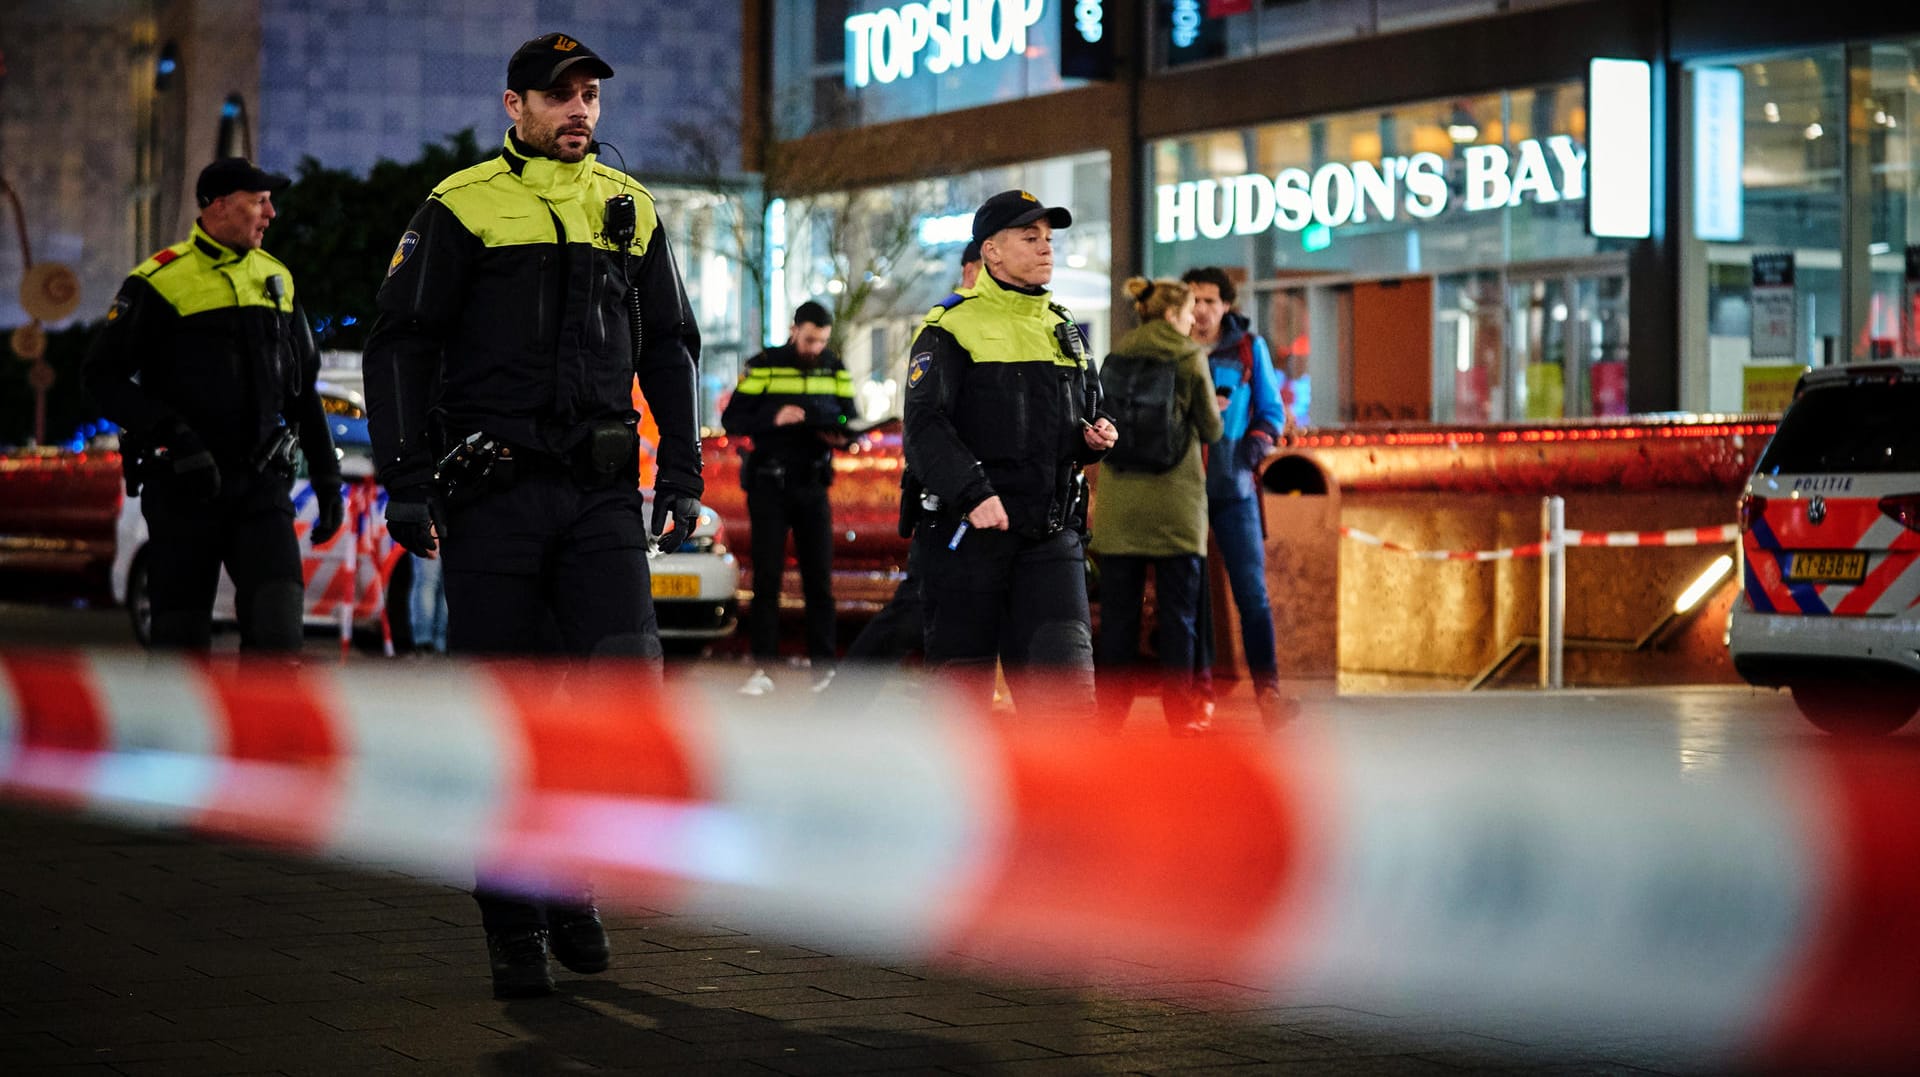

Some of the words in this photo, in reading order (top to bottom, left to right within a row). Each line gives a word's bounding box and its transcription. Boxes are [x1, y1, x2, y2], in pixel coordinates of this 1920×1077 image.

[846, 0, 1043, 87] TOPSHOP
[1155, 151, 1449, 244] HUDSON'S
[1463, 134, 1587, 212] BAY
[1794, 478, 1854, 491] POLITIE
